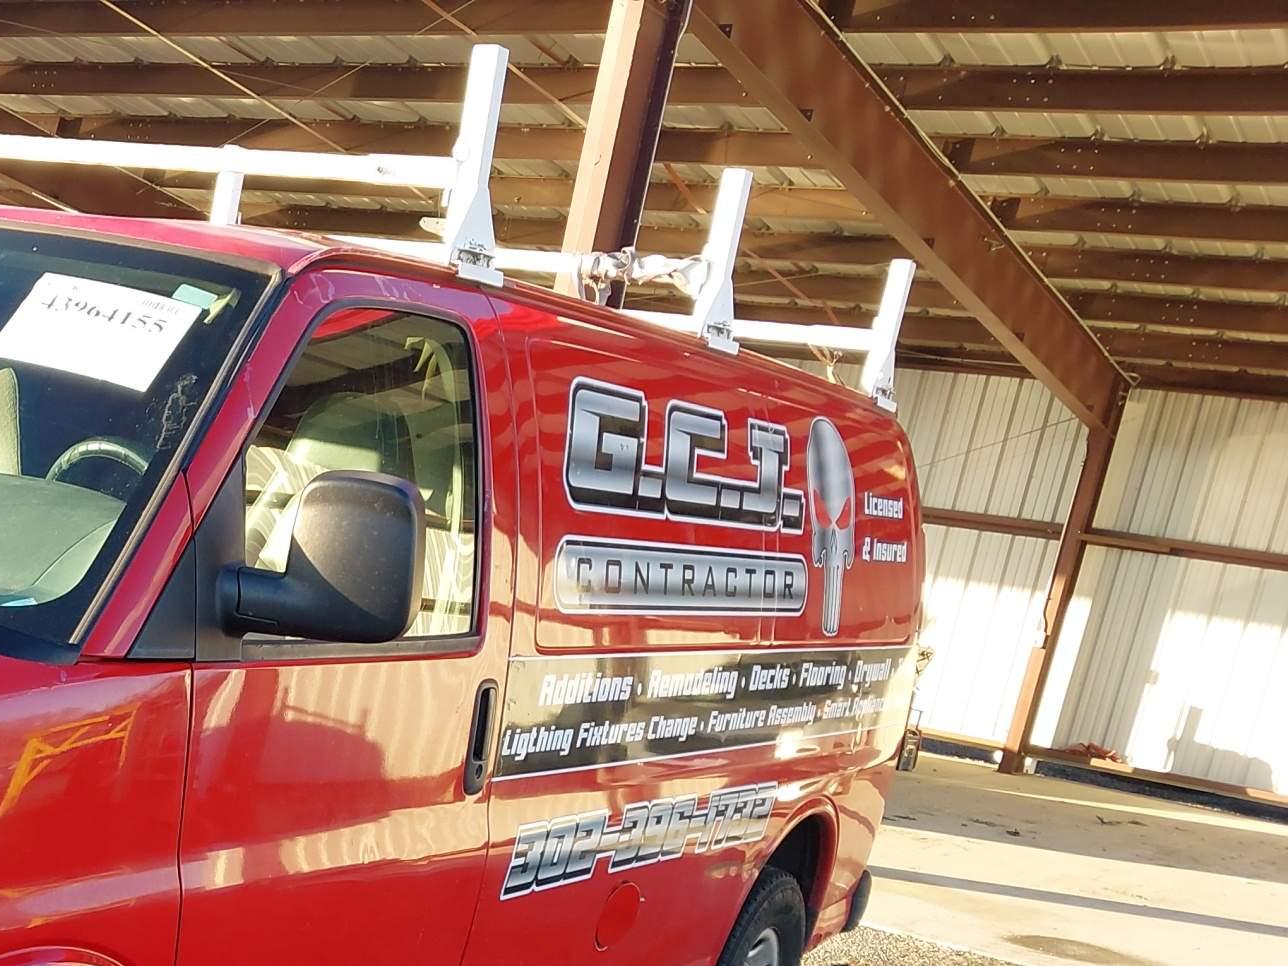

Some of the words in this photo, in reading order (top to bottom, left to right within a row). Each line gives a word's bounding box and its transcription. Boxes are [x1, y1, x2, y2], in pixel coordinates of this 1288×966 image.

[41, 295, 168, 333] 43964155
[567, 380, 805, 534] G.C.J.
[864, 491, 904, 519] Licensed
[862, 536, 871, 562] &
[873, 538, 908, 562] Insured
[576, 556, 795, 602] CONTRACTOR
[538, 672, 634, 707] Additions
[647, 666, 739, 700] Remodeling
[749, 664, 791, 692] Decks
[799, 661, 847, 694] Flooring
[854, 657, 892, 688] Drywall
[501, 725, 575, 761] Ligthing
[576, 720, 646, 748] Fixtures
[647, 715, 699, 742] Change
[706, 707, 767, 734] Furniture
[767, 701, 817, 726] Assembly
[823, 698, 851, 720] Smart
